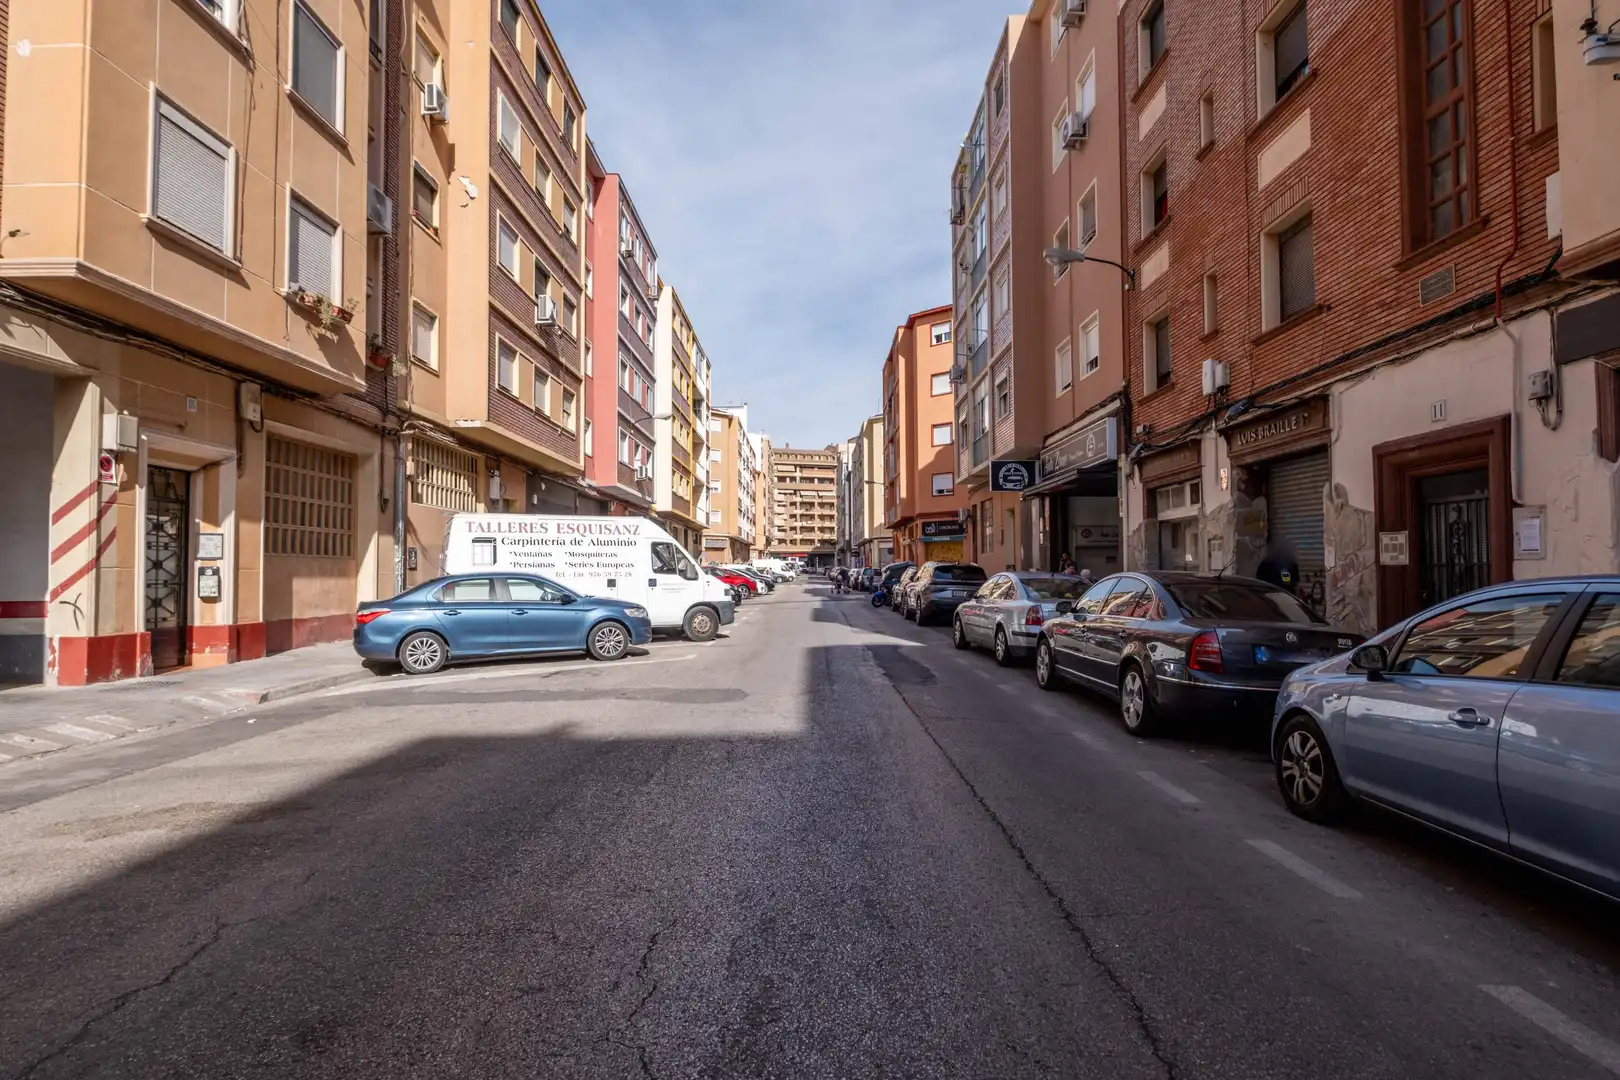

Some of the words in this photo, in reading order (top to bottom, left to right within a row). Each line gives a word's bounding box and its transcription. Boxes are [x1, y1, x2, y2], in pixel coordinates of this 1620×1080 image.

[1237, 428, 1256, 445] LUIS
[1258, 416, 1297, 439] BRAILLE
[465, 521, 549, 534] TALLERES
[556, 522, 641, 538] ESQUISANZ
[501, 536, 566, 547] Carpintería
[569, 537, 584, 547] de
[587, 537, 637, 547] Aluminio
[567, 551, 618, 559] Mosquiteras
[568, 560, 594, 568] Series
[596, 561, 635, 570] Europeas
